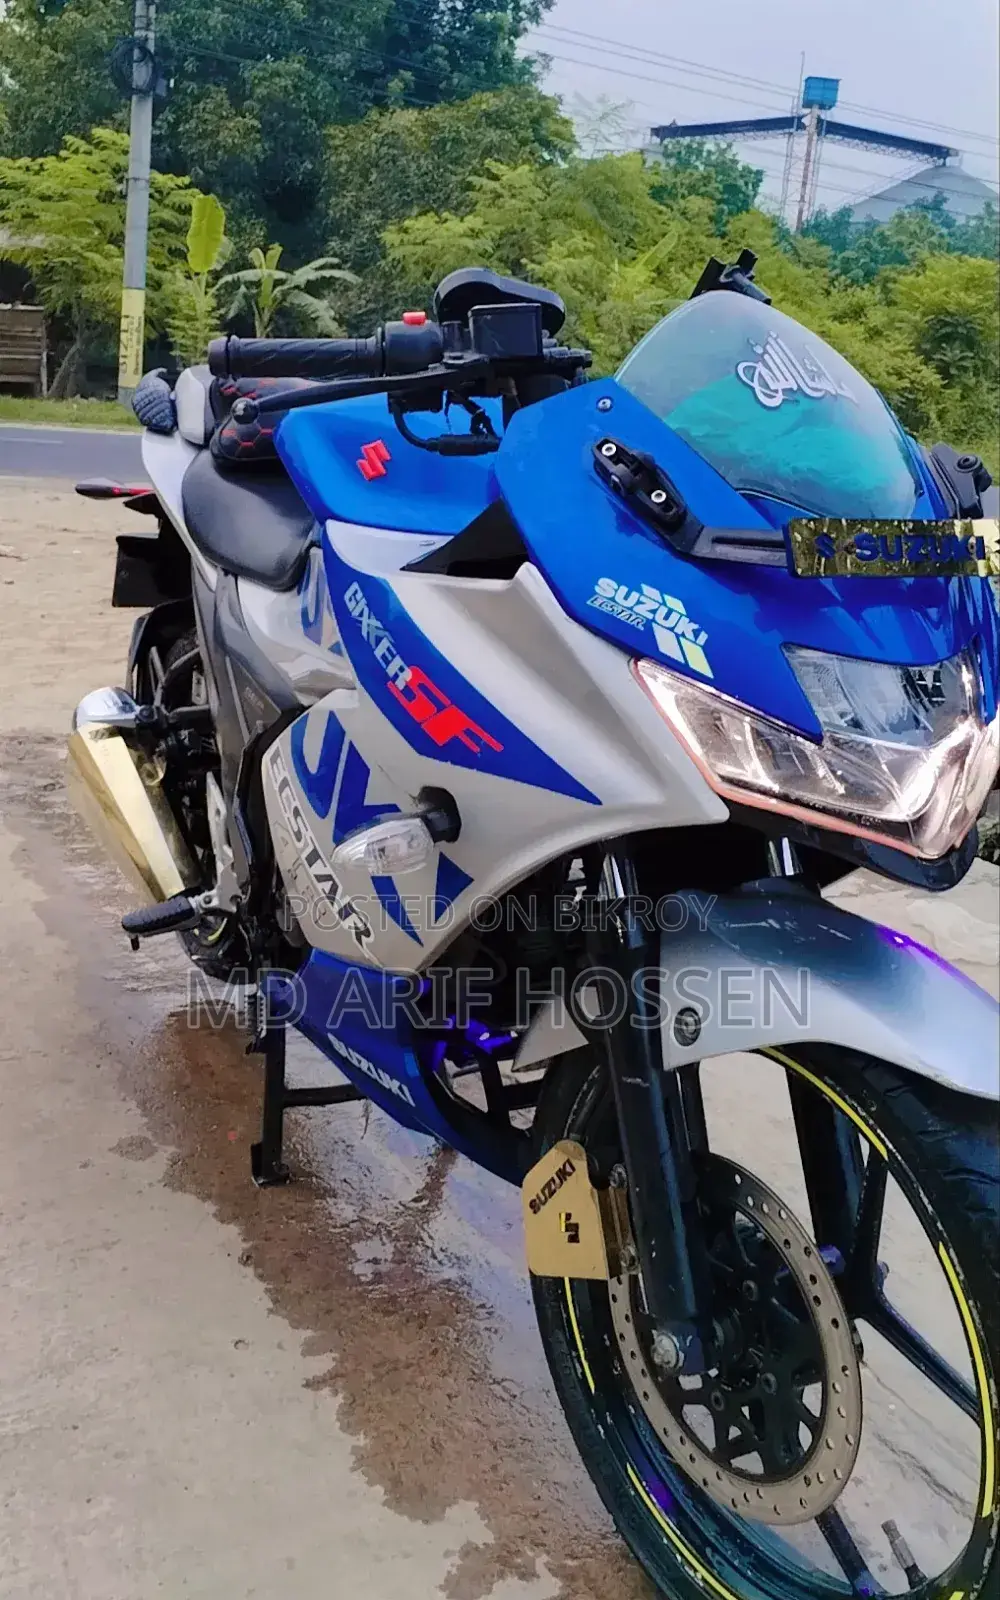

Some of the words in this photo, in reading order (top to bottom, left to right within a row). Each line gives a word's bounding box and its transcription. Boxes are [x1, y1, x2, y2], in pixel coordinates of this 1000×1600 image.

[853, 532, 985, 562] SUZUKI
[594, 577, 708, 646] SUZUKI
[344, 581, 413, 690] GIXXER
[387, 665, 504, 752] SF
[267, 743, 374, 950] ECSTAR
[327, 1032, 415, 1107] SUZUKI
[529, 1158, 576, 1214] SUZUKI
